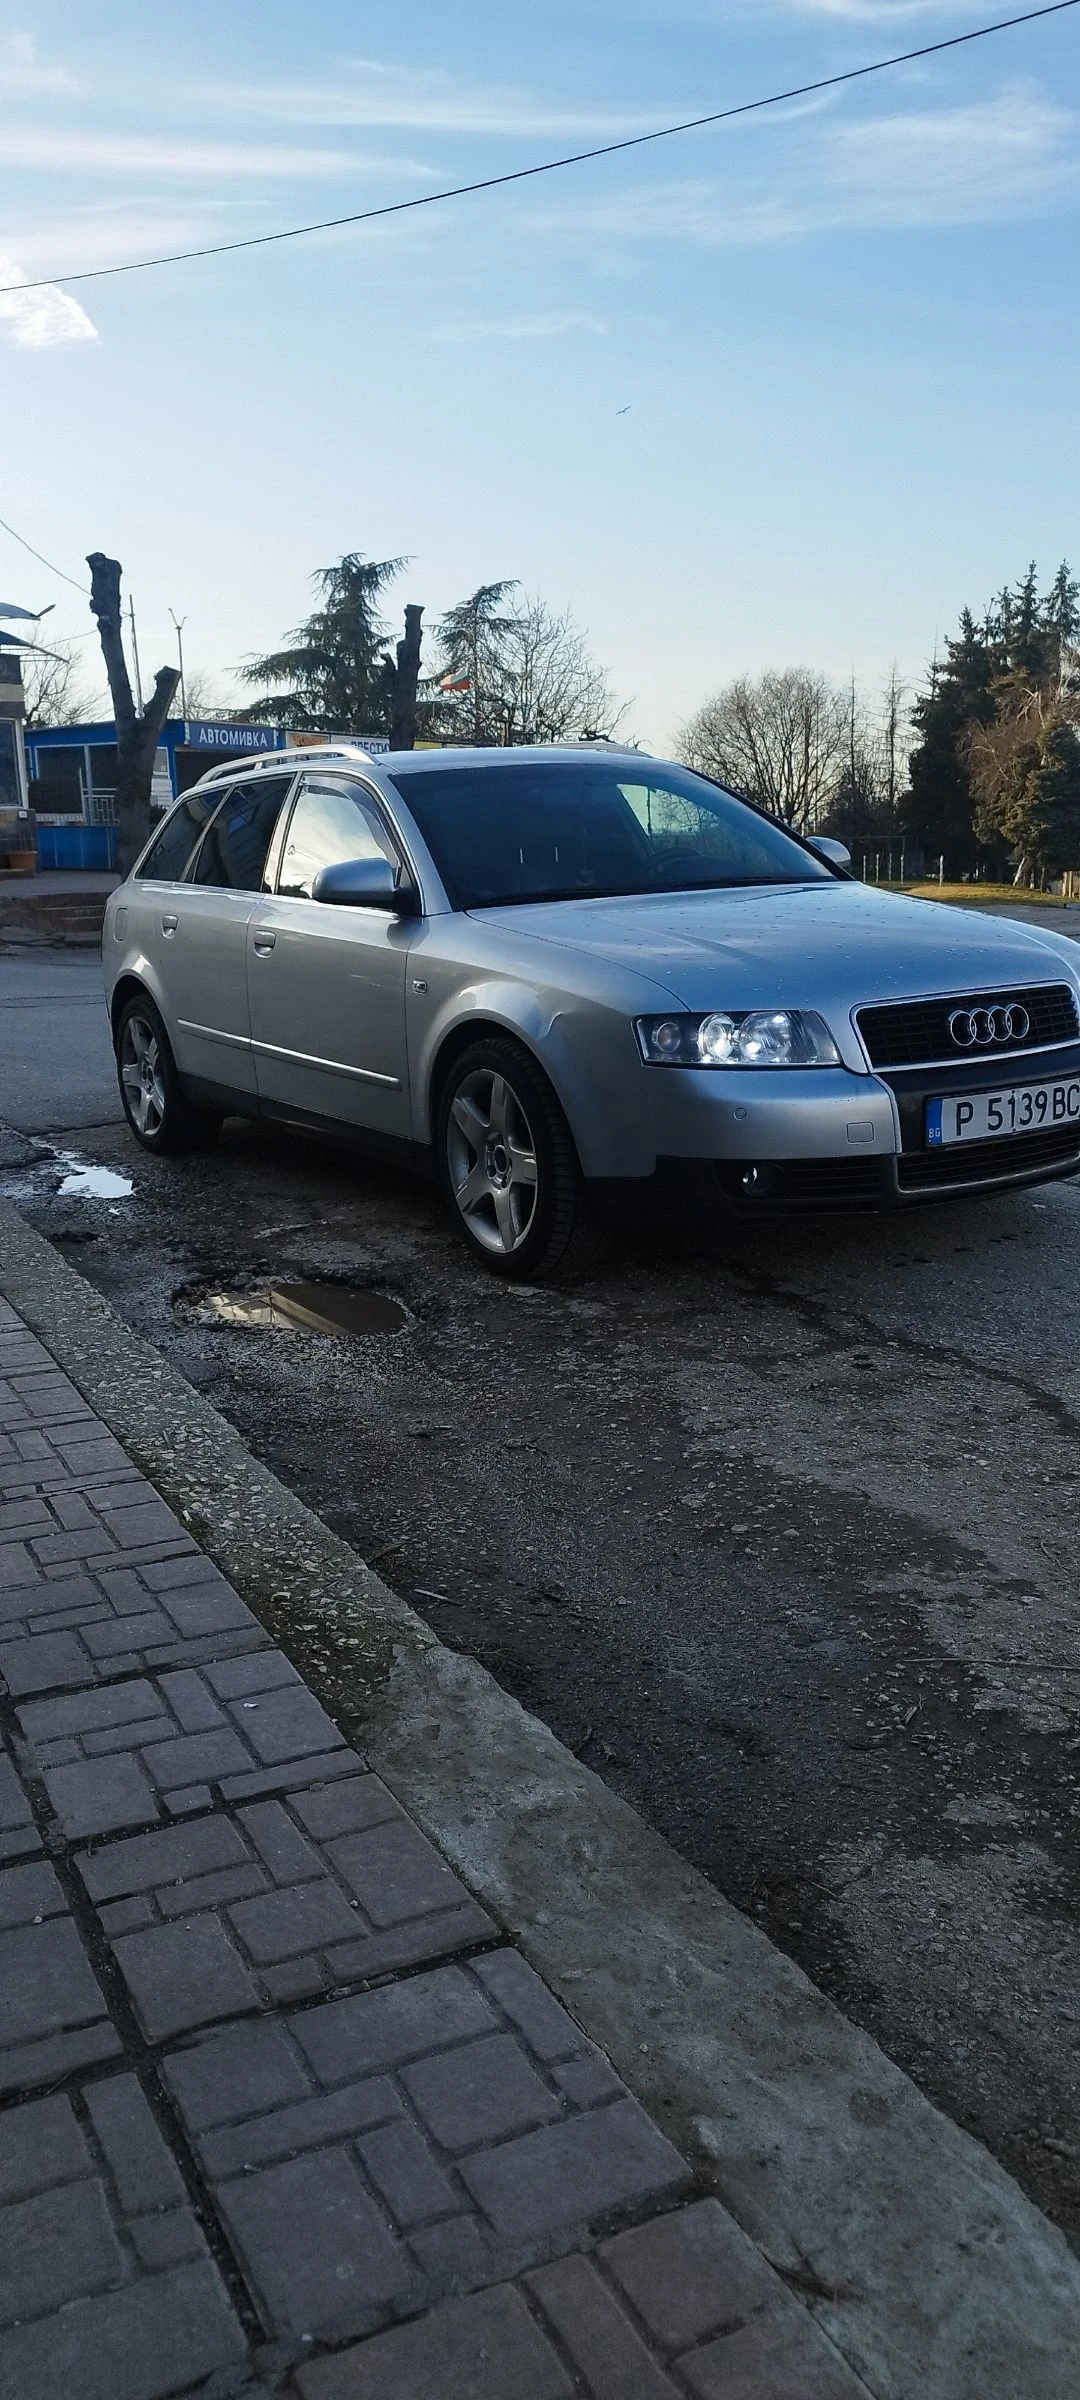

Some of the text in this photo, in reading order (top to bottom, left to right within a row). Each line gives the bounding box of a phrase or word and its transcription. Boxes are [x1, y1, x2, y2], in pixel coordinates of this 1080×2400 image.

[199, 727, 268, 747] АВТОМИВКА
[955, 1101, 974, 1137] P
[987, 1090, 1048, 1131] 5139
[928, 1127, 941, 1139] BG
